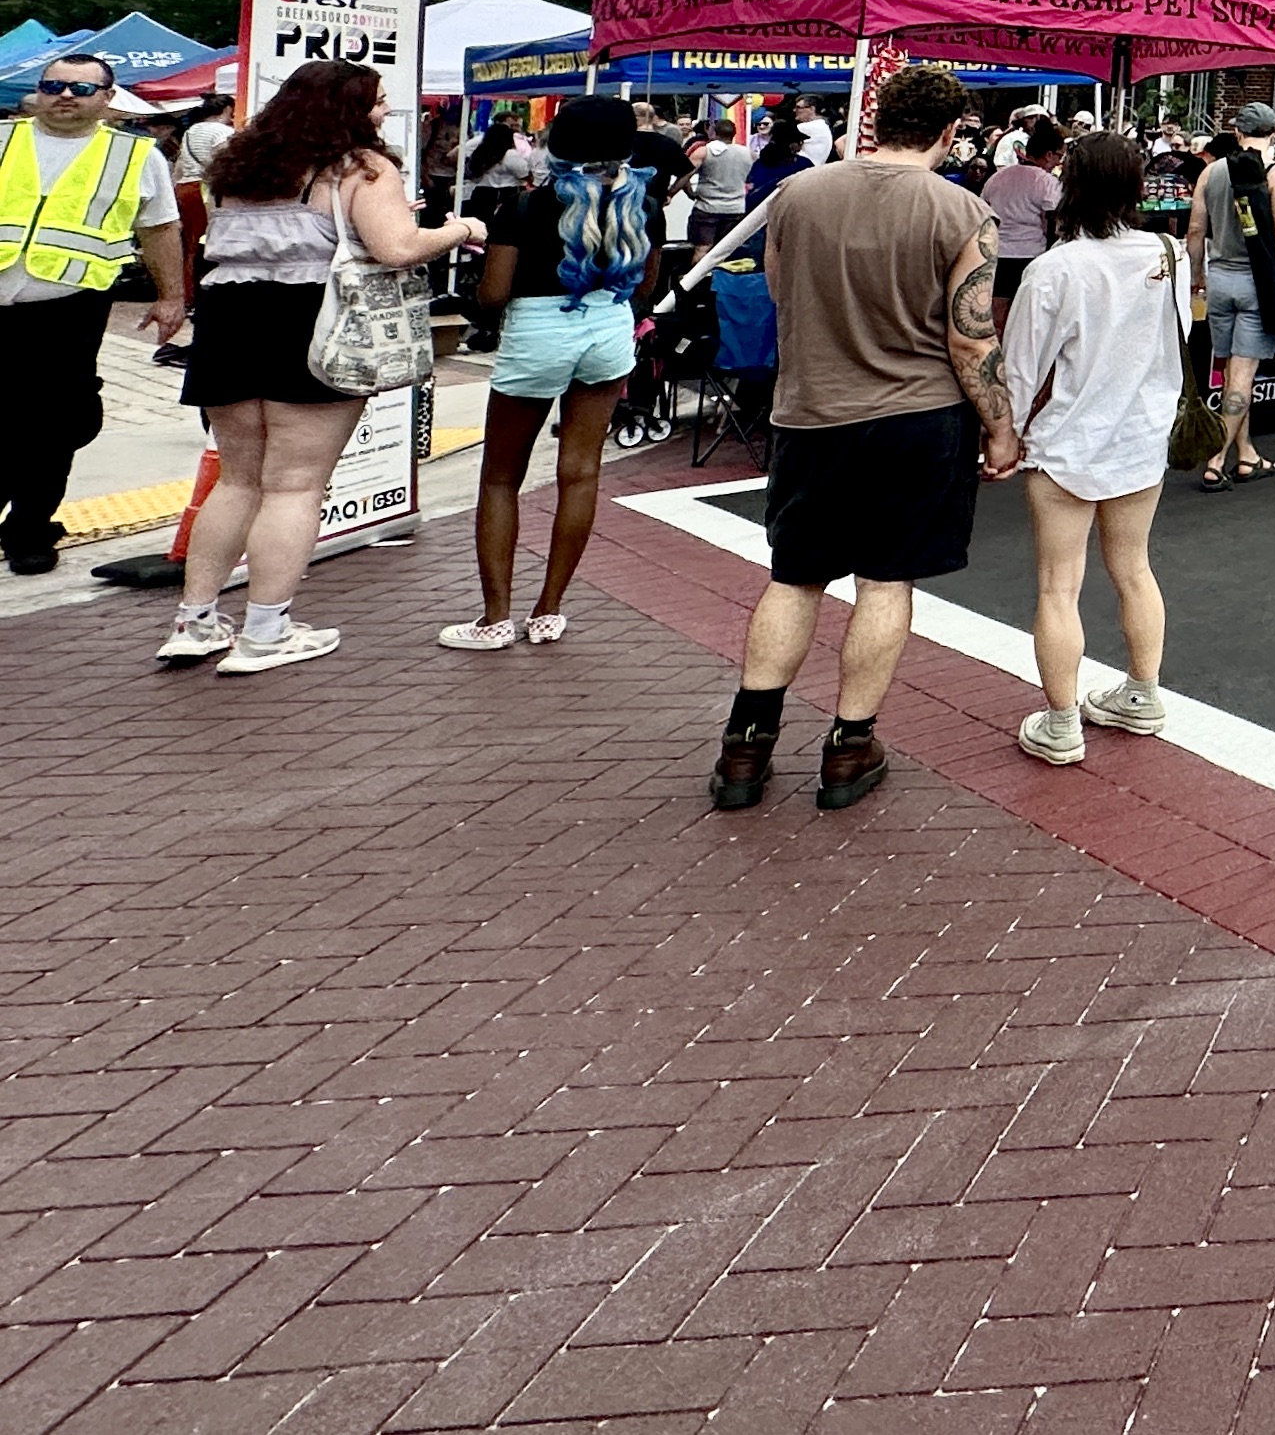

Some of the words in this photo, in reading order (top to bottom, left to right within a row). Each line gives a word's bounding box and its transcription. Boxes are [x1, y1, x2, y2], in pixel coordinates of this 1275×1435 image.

[276, 5, 350, 25] GREENSBORO
[275, 20, 398, 65] PRIDE
[127, 51, 184, 61] DUKE
[374, 488, 406, 510] GSO
